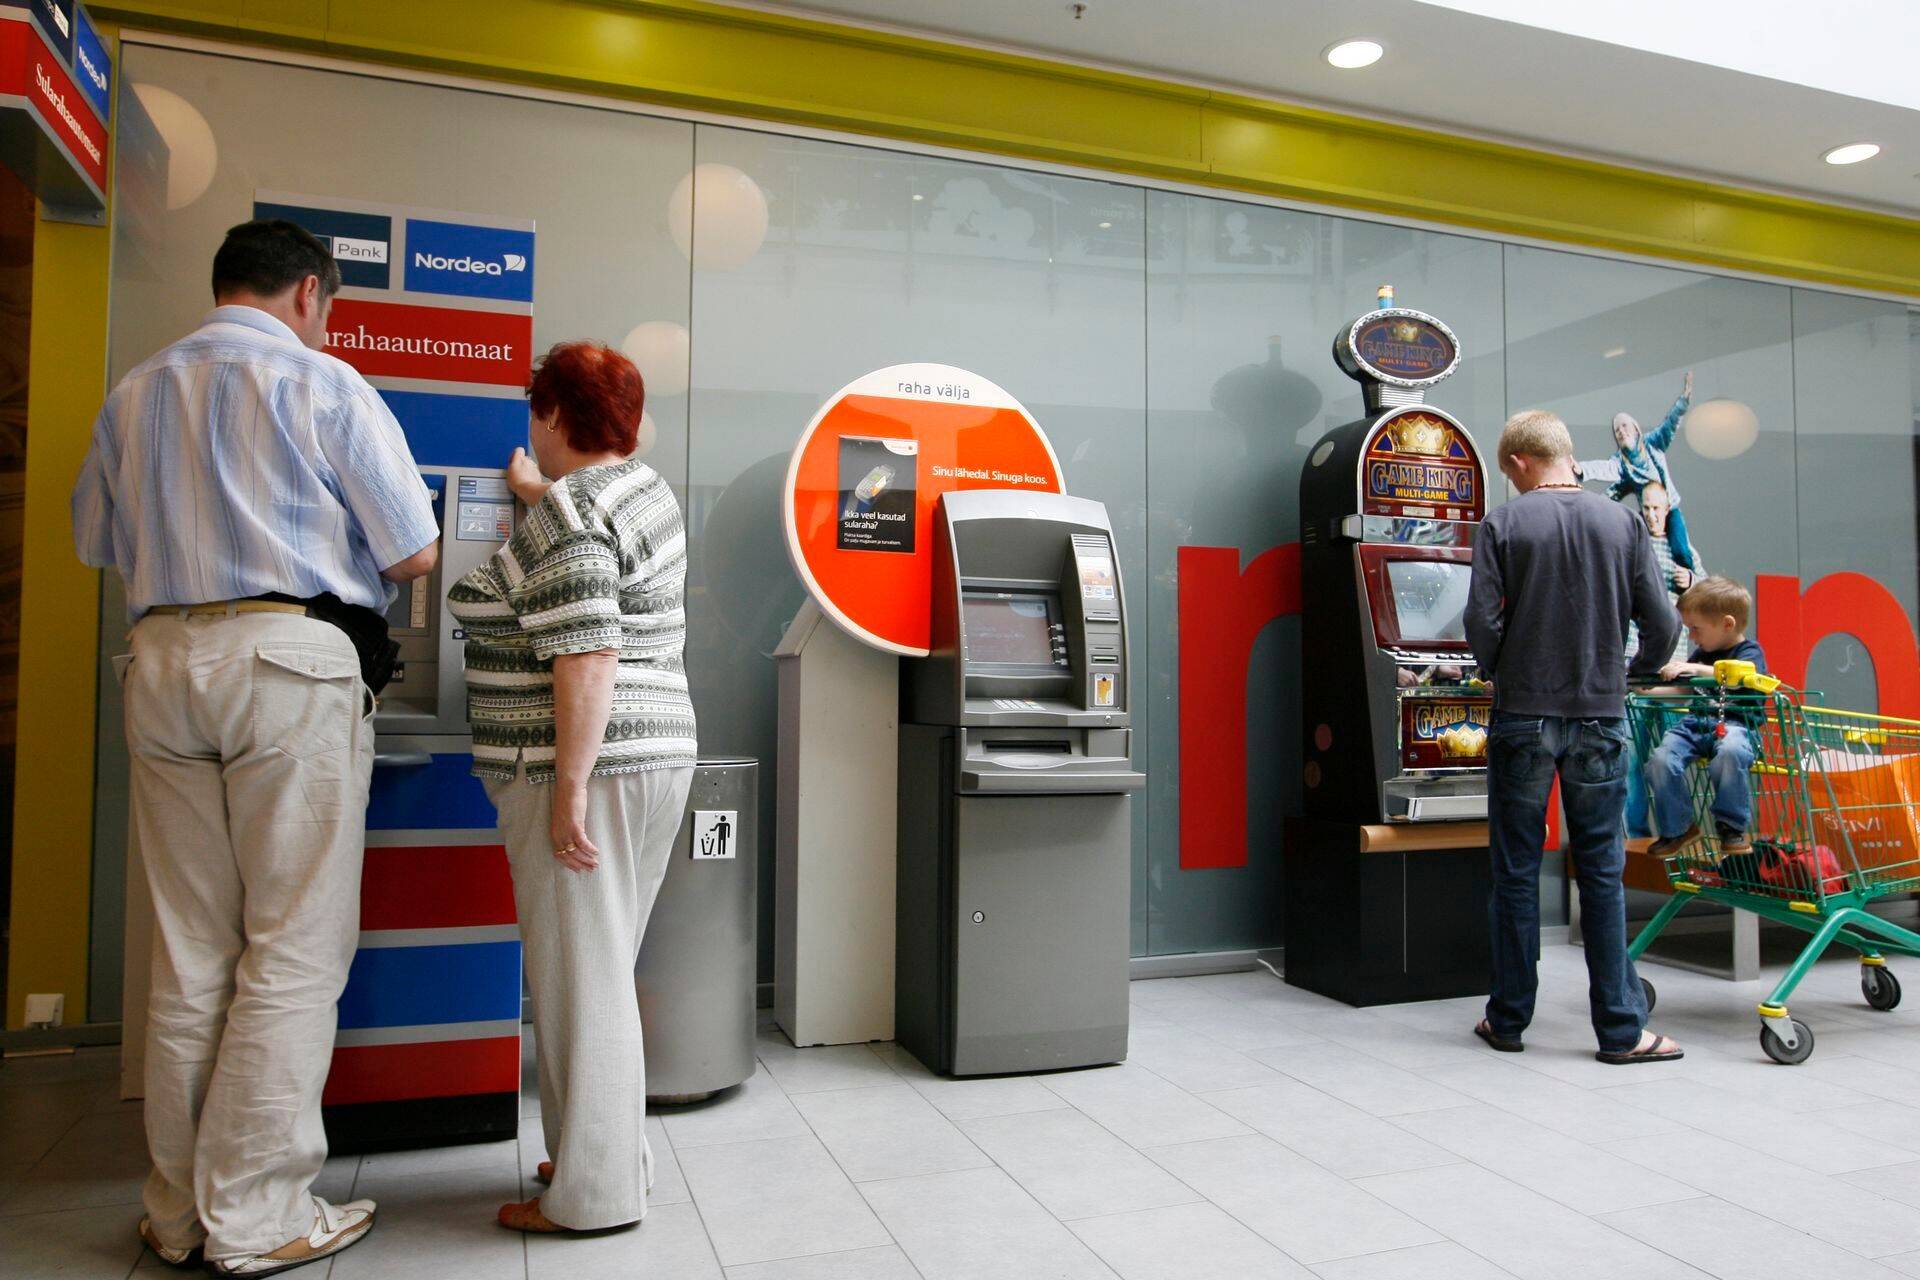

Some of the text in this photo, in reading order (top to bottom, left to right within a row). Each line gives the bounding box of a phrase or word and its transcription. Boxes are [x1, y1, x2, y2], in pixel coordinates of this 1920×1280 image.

[337, 242, 382, 259] Pank
[415, 251, 502, 276] Nordea
[325, 324, 513, 361] rahaautomaat
[898, 381, 971, 400] raha välja
[932, 465, 1048, 485] Sinu lähedal. Sinuga koos.
[1371, 462, 1472, 501] GAME KING
[1395, 487, 1449, 501] MULTI-GAME
[844, 520, 878, 529] sularaha?
[877, 512, 905, 521] kasutad
[1415, 705, 1491, 738] GAME KI
